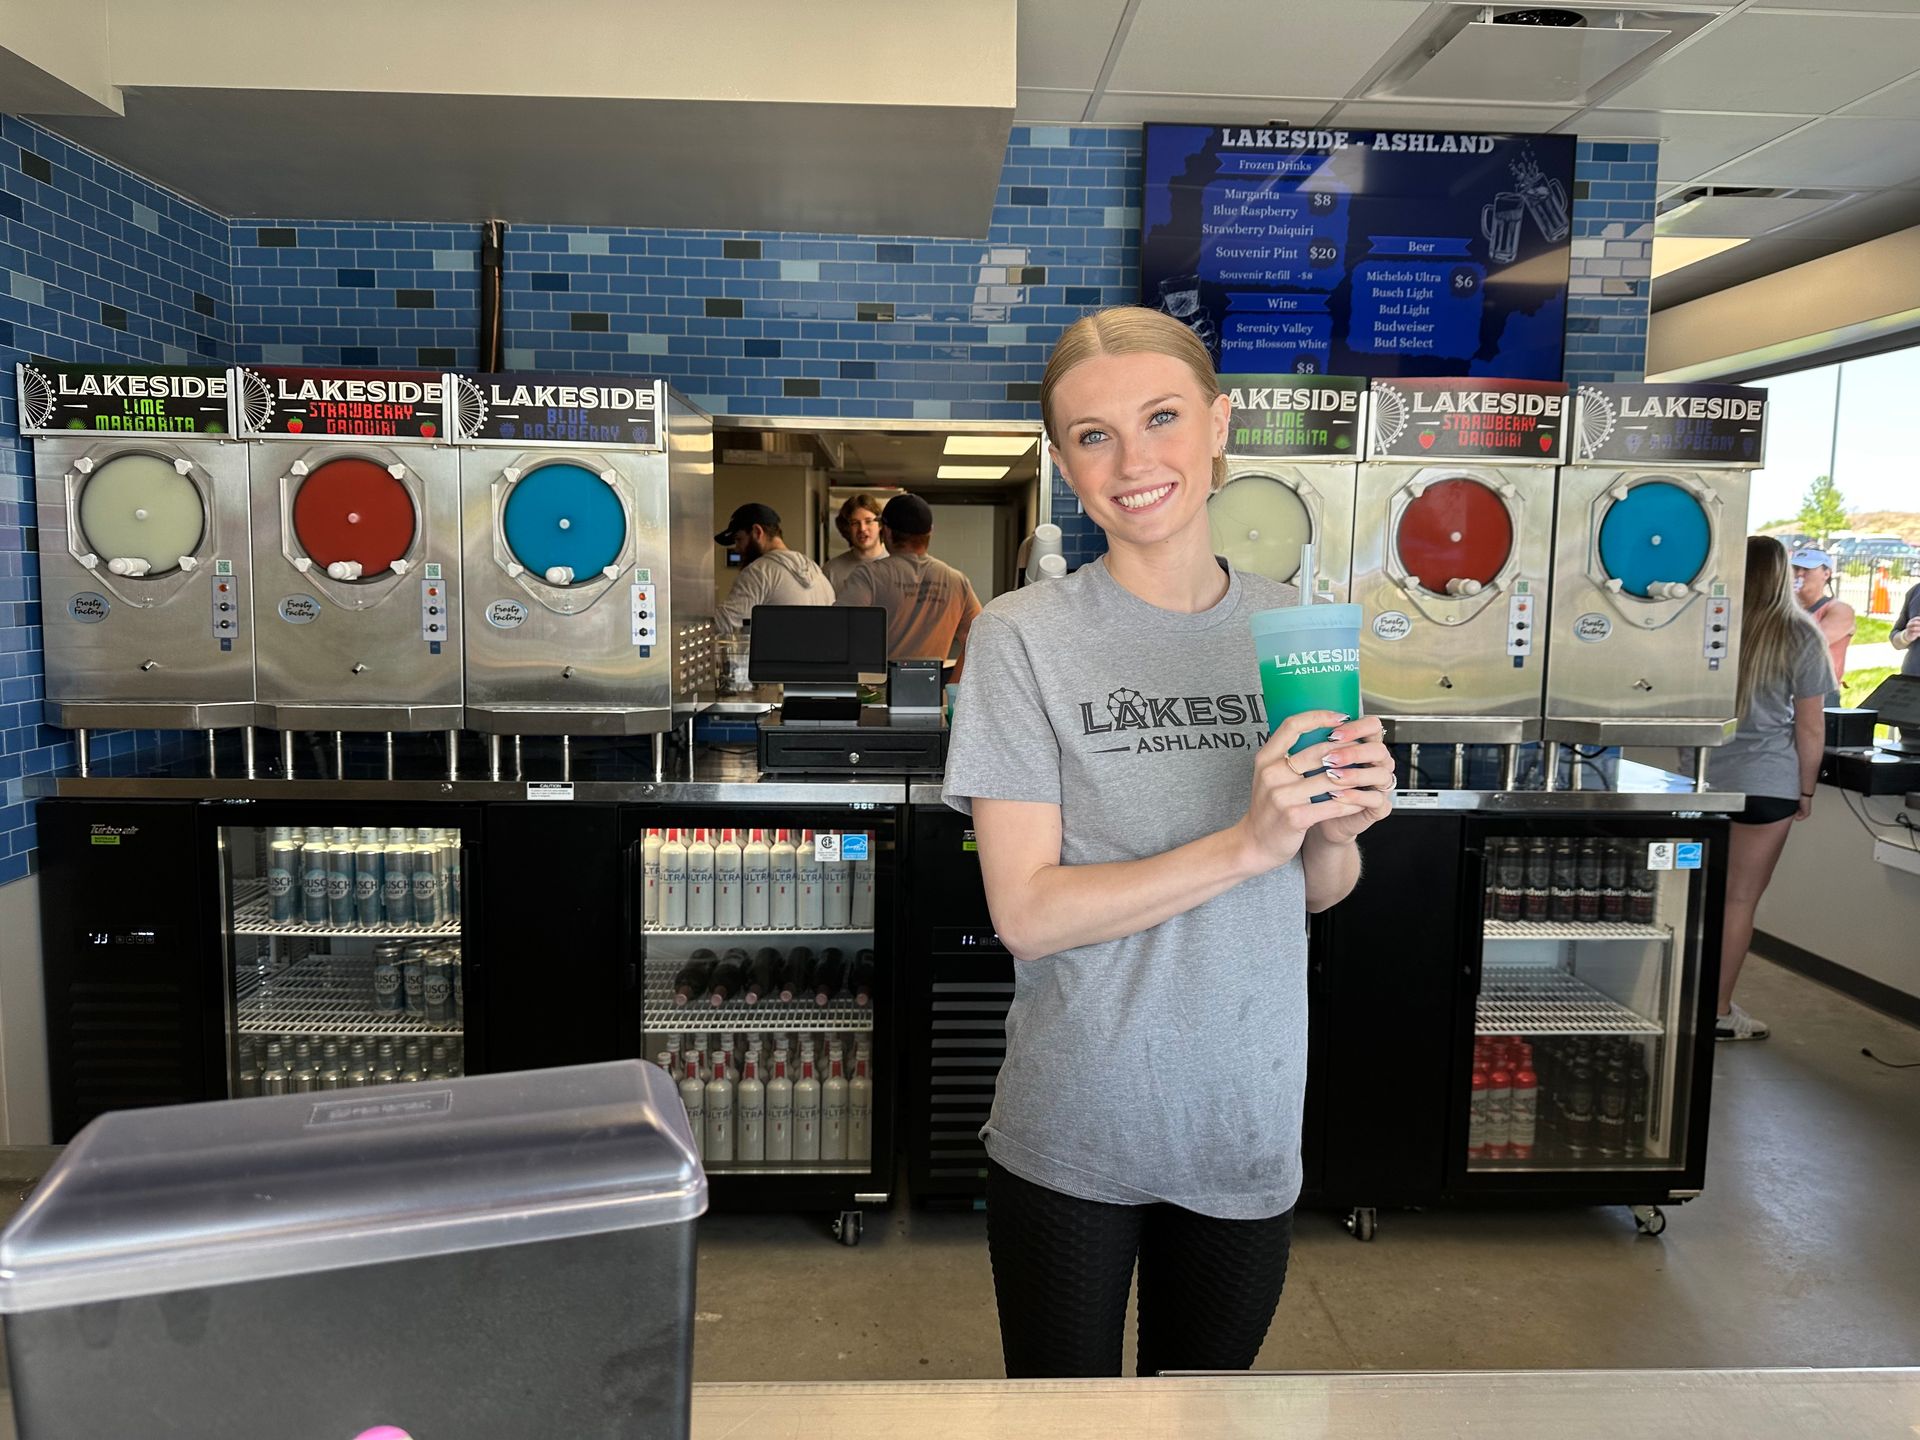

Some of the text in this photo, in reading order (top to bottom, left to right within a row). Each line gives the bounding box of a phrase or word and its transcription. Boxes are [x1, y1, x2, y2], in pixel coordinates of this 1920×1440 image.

[1222, 128, 1349, 150] LAKESIDE
[1372, 133, 1495, 153] ASHLAND
[1239, 160, 1312, 171] Frozen Drinks
[1225, 189, 1280, 202] Margarita
[1314, 193, 1331, 207] $8
[1213, 205, 1298, 219] Blue Raspberry
[1202, 224, 1314, 238] Strawberry Daiquiri
[1216, 247, 1298, 259] Souvenir Pint
[1310, 246, 1337, 260] $20
[1408, 241, 1435, 252] Beer
[1220, 270, 1263, 280] Souvenir
[1265, 270, 1290, 280] Refill
[1367, 271, 1441, 282] Michelob Ultra
[1455, 275, 1473, 288] $6
[1372, 288, 1433, 300] Busch Light
[1267, 298, 1298, 309] Wine
[1379, 304, 1430, 317] Bud Light
[1236, 323, 1313, 335] Serenity Valley
[1374, 321, 1434, 332] Budweiser
[1221, 339, 1327, 350] Spring Blossom White
[1374, 337, 1433, 348] Bud Select
[1297, 363, 1314, 374] $8
[57, 374, 228, 399] LAKESIDE
[277, 378, 443, 404] LAKESIDE
[491, 384, 655, 410] LAKESIDE
[1228, 388, 1357, 412] AKESIDE
[1413, 391, 1561, 417] LAKESIDE
[124, 399, 165, 415] LIME
[309, 402, 413, 420] STRAWBERRY
[1619, 396, 1762, 421] LAKESIDE
[95, 415, 195, 432] MARGARITA
[548, 408, 589, 425] BLUE
[1265, 411, 1306, 428] LIME
[1443, 414, 1537, 431] STRAWBERRY
[523, 423, 620, 440] RASPBERRY
[1675, 420, 1713, 435] BLUE
[1235, 428, 1328, 446] MARGARITA
[1459, 431, 1522, 448] DAIQUIRI
[1649, 434, 1735, 450] RASPBERRY
[76, 598, 102, 608] Frosty
[287, 600, 313, 611] Frosty
[494, 605, 520, 615] Frosty
[74, 606, 104, 617] Factory
[285, 608, 315, 619] Factory
[493, 612, 522, 622] Factory
[1380, 617, 1406, 627] Frosty
[1378, 625, 1406, 634] Factory
[1079, 694, 1266, 736] LAKESI
[1136, 731, 1271, 755] ASHLAND, M
